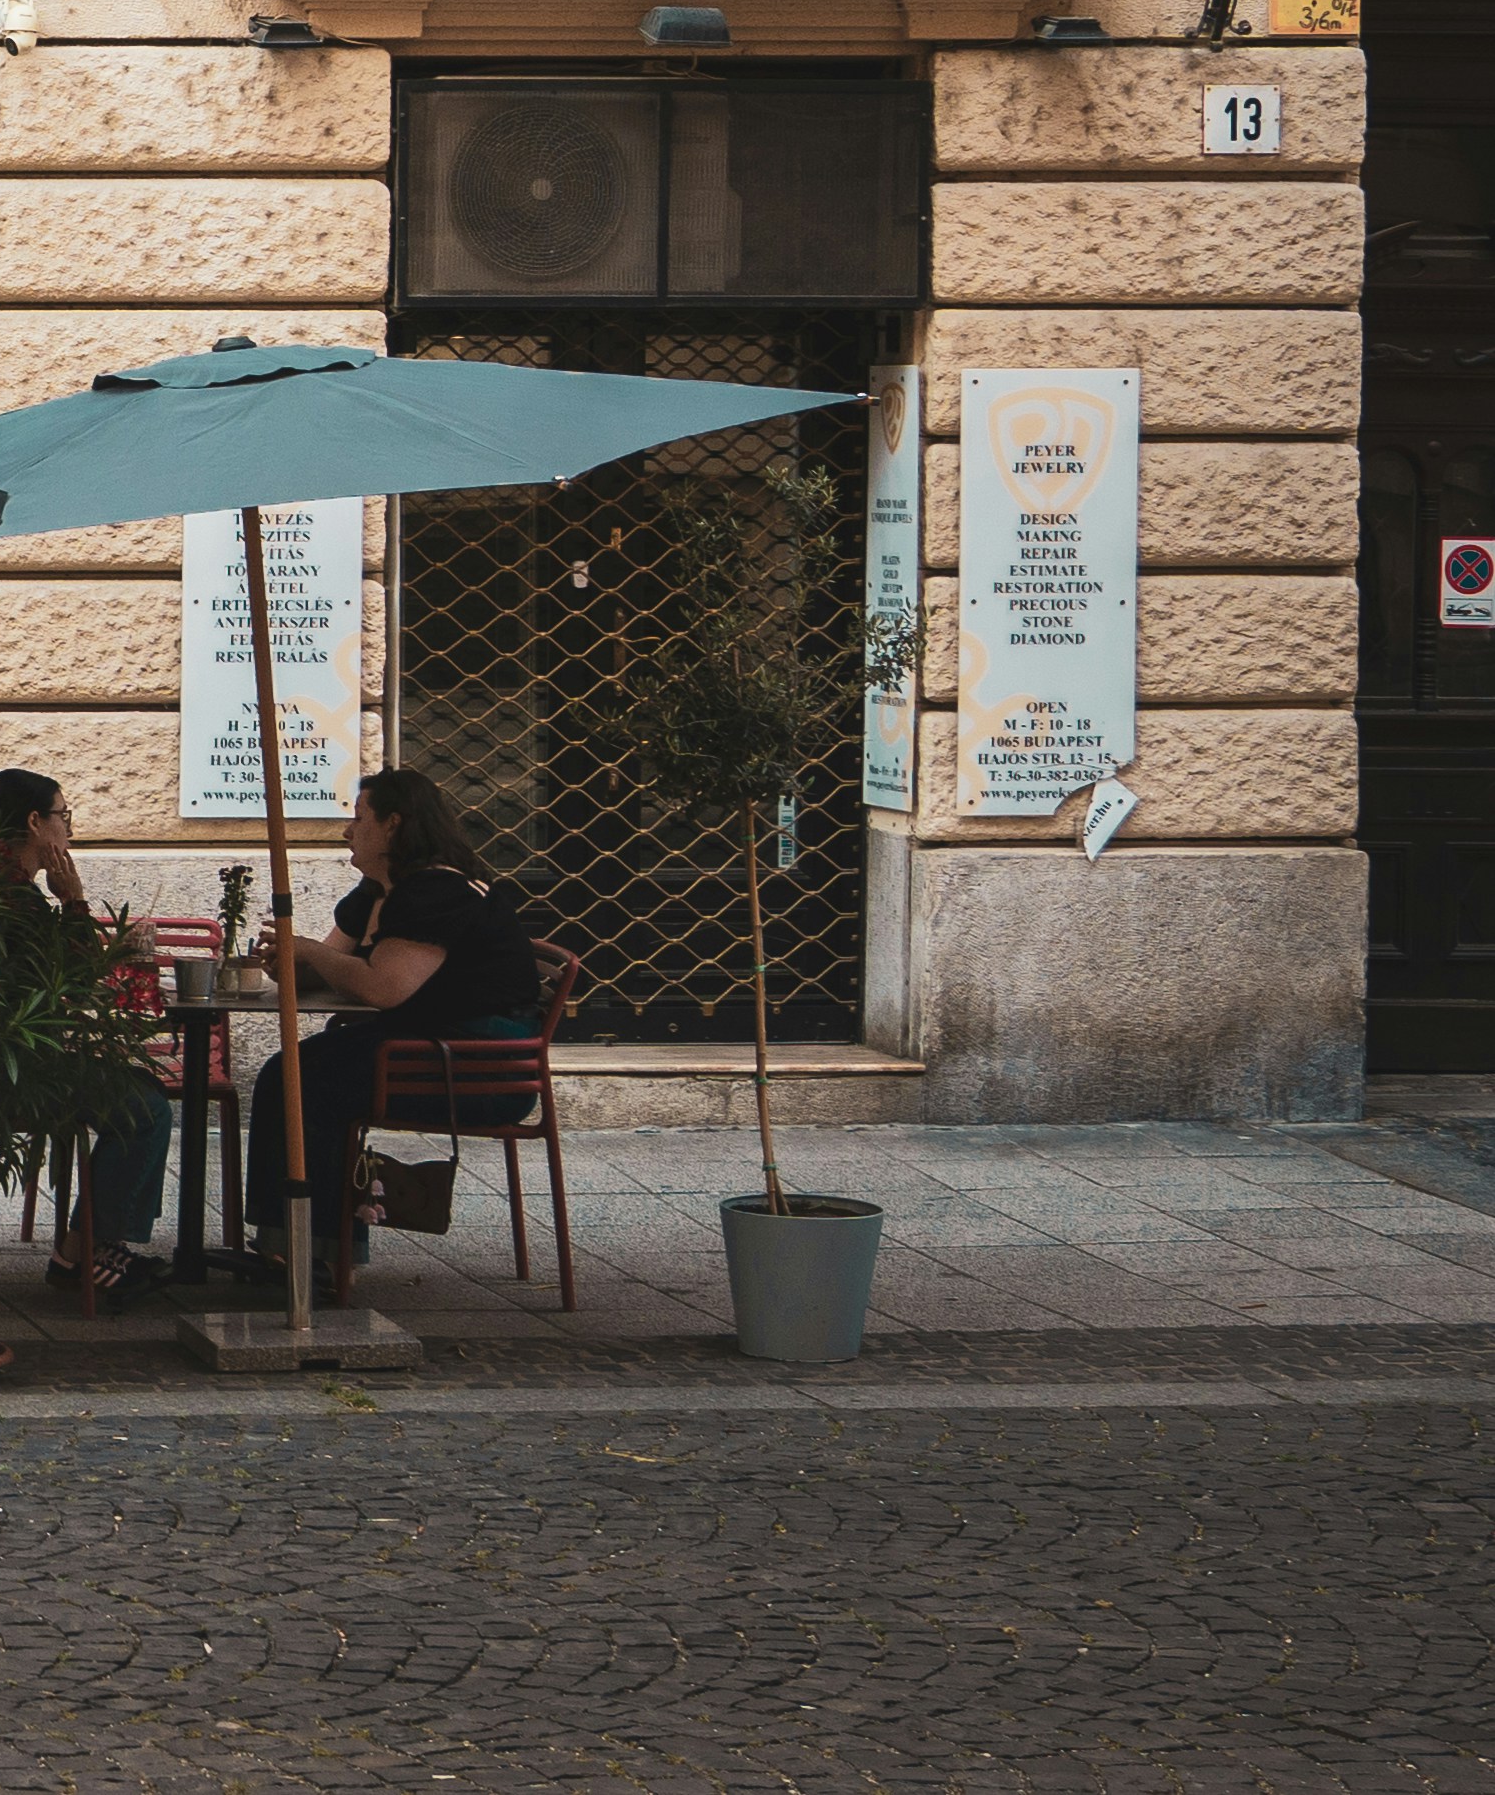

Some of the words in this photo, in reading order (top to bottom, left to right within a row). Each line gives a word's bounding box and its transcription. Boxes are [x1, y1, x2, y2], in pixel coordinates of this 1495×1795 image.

[1224, 97, 1262, 142] 13
[1025, 445, 1076, 457] PEYER
[1012, 462, 1087, 474] JEWELRY
[1020, 513, 1078, 525] DESIGN
[1017, 530, 1082, 542] MAKING
[1020, 547, 1077, 559] REPAIR
[1009, 564, 1088, 576] ESTIMATE
[236, 579, 308, 594] ÁÉTEL
[993, 582, 1103, 594] RESTORATION
[211, 596, 333, 611] ÉRTÉBECSLÉS
[1009, 598, 1087, 610] PRECIOUS
[214, 617, 253, 628] ANTI
[269, 613, 330, 628] ÉKSZER
[1022, 616, 1073, 628] STONE
[1010, 633, 1086, 645] DIAMOND
[215, 647, 328, 663] RESTRÁLÁS
[1026, 701, 1068, 713] OPEN
[227, 720, 239, 731] H
[300, 720, 314, 731] 18
[1003, 719, 1017, 730] M
[1030, 719, 1044, 730] F:
[1049, 719, 1063, 730] 10
[1077, 719, 1091, 730] 18
[213, 737, 243, 749] 1065
[247, 737, 329, 749] BAPEST
[990, 736, 1020, 748] 1065
[1024, 736, 1104, 747] BUDAPEST
[210, 751, 261, 766] HAJÓS
[284, 755, 299, 766] 13
[313, 755, 331, 766] 15.
[978, 750, 1028, 765] HAJÓS
[1032, 753, 1064, 765] STR.
[1070, 753, 1084, 765] 13
[221, 772, 235, 783] T:
[988, 770, 1003, 782] T:
